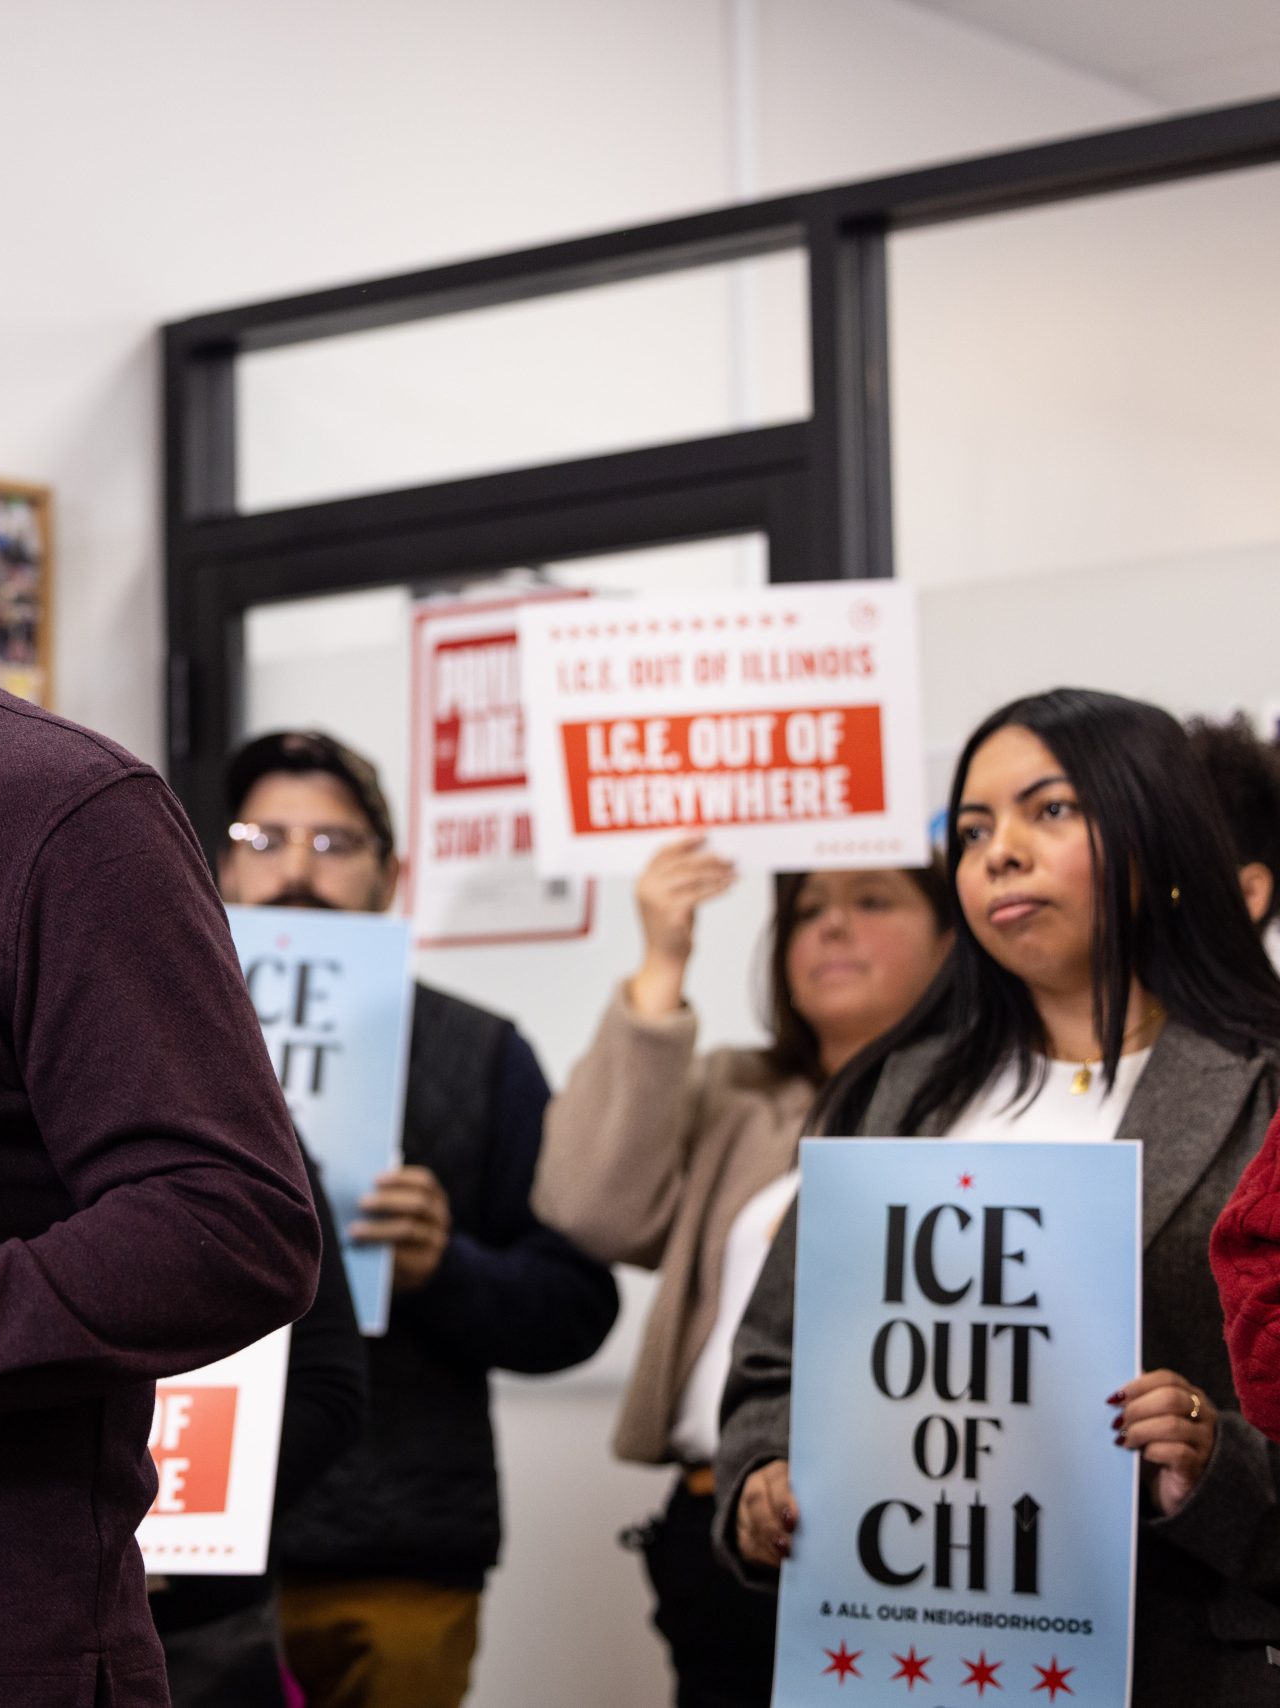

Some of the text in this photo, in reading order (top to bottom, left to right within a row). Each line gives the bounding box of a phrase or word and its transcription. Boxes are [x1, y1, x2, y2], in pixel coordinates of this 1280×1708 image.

[629, 654, 683, 690] OUT
[693, 650, 728, 685] OF
[741, 645, 877, 684] ILLINOIS
[586, 709, 846, 773] I.C.E. OUT OF
[587, 764, 852, 829] EVERYWHERE
[244, 954, 341, 1032] CE
[882, 1204, 1043, 1308] ICE
[870, 1317, 1052, 1405] OUT
[911, 1413, 1003, 1482] OF
[855, 1488, 1042, 1596] CHI
[820, 1601, 1094, 1636] & ALL OUR NEIGHBORHOODS
